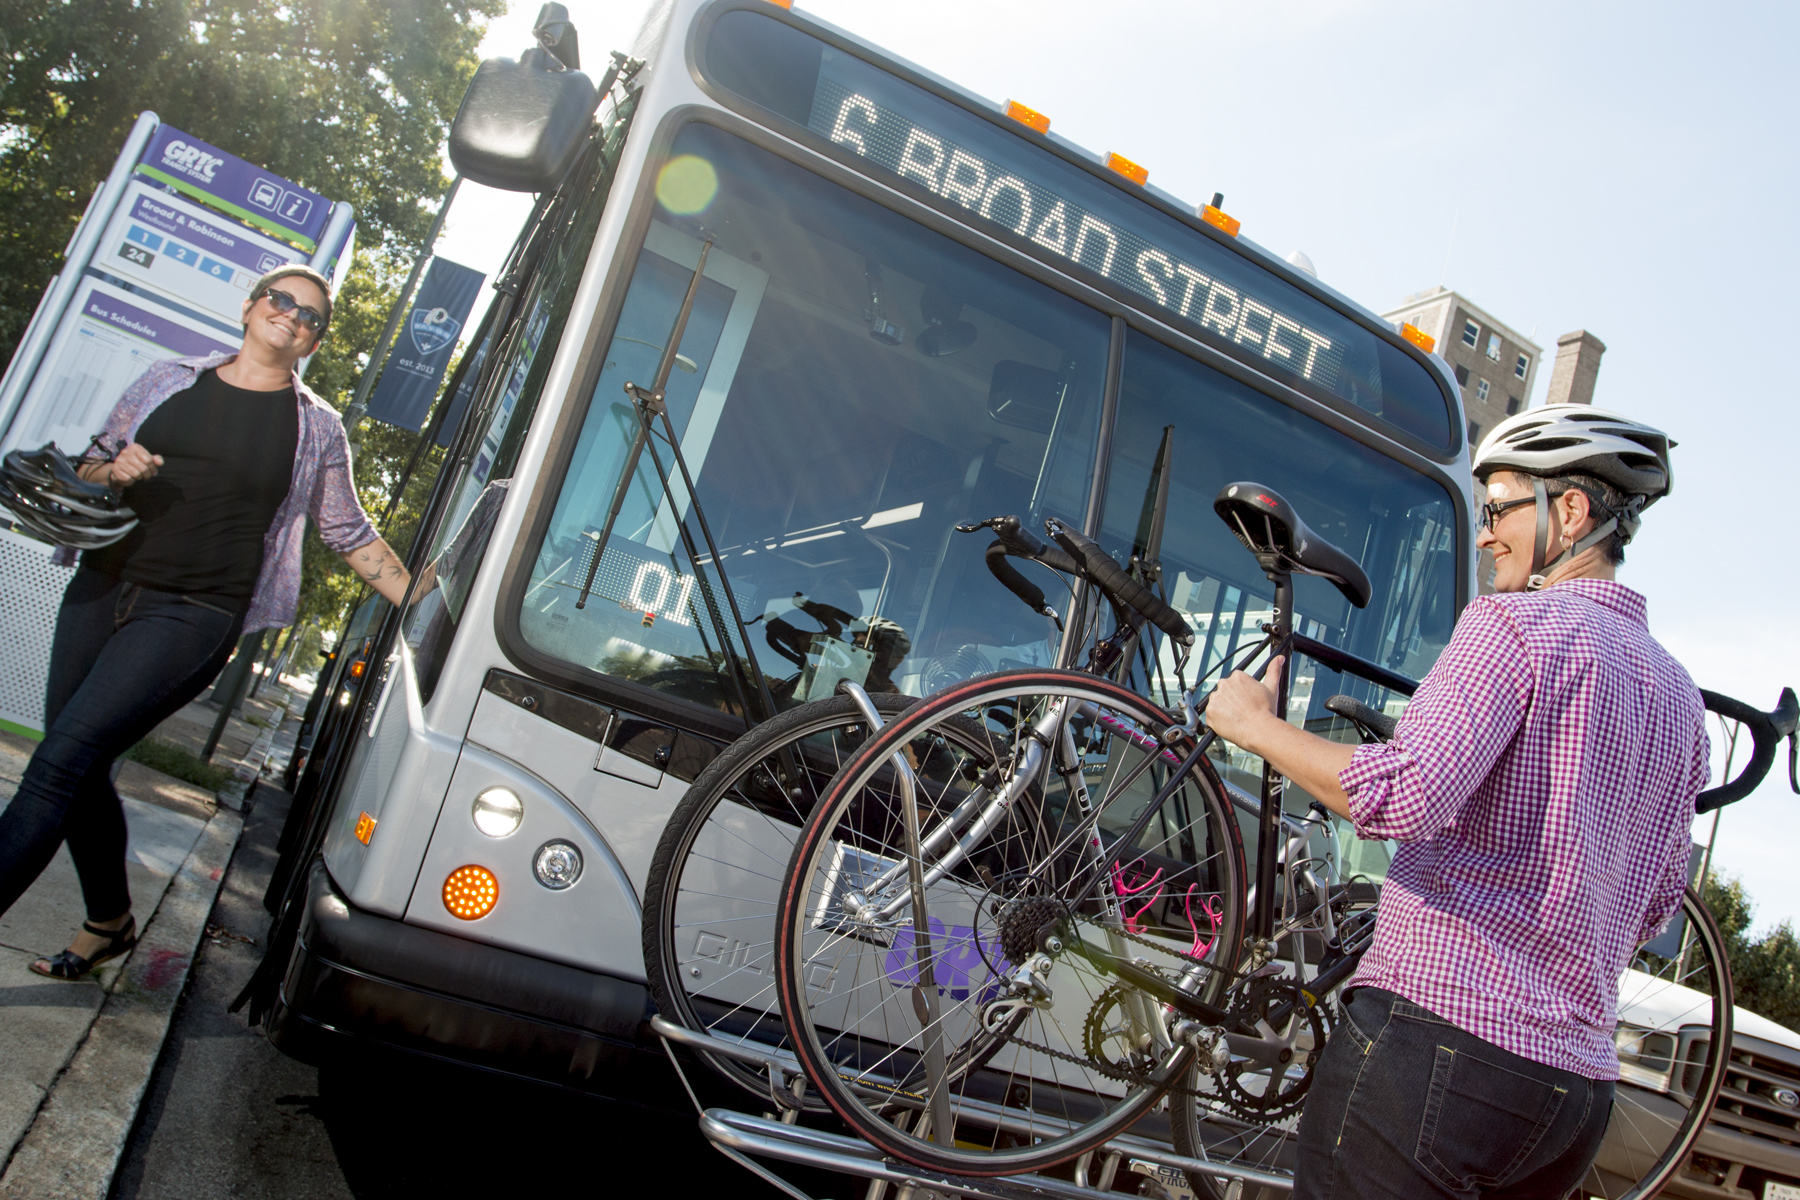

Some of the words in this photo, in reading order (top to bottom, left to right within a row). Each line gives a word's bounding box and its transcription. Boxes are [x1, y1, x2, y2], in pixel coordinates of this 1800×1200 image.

[161, 156, 189, 173] TRANSIT
[187, 168, 213, 184] SYSTEM
[164, 139, 225, 178] GRTC
[137, 209, 178, 233] Westbound
[141, 199, 176, 220] Broad
[176, 215, 186, 225] &
[187, 219, 236, 248] Robinson
[126, 248, 147, 263] 24
[141, 232, 149, 243] 1
[175, 248, 187, 260] 2
[211, 265, 222, 276] 6
[90, 303, 109, 318] Bus
[109, 312, 158, 338] Schedules
[415, 363, 435, 375] 2013
